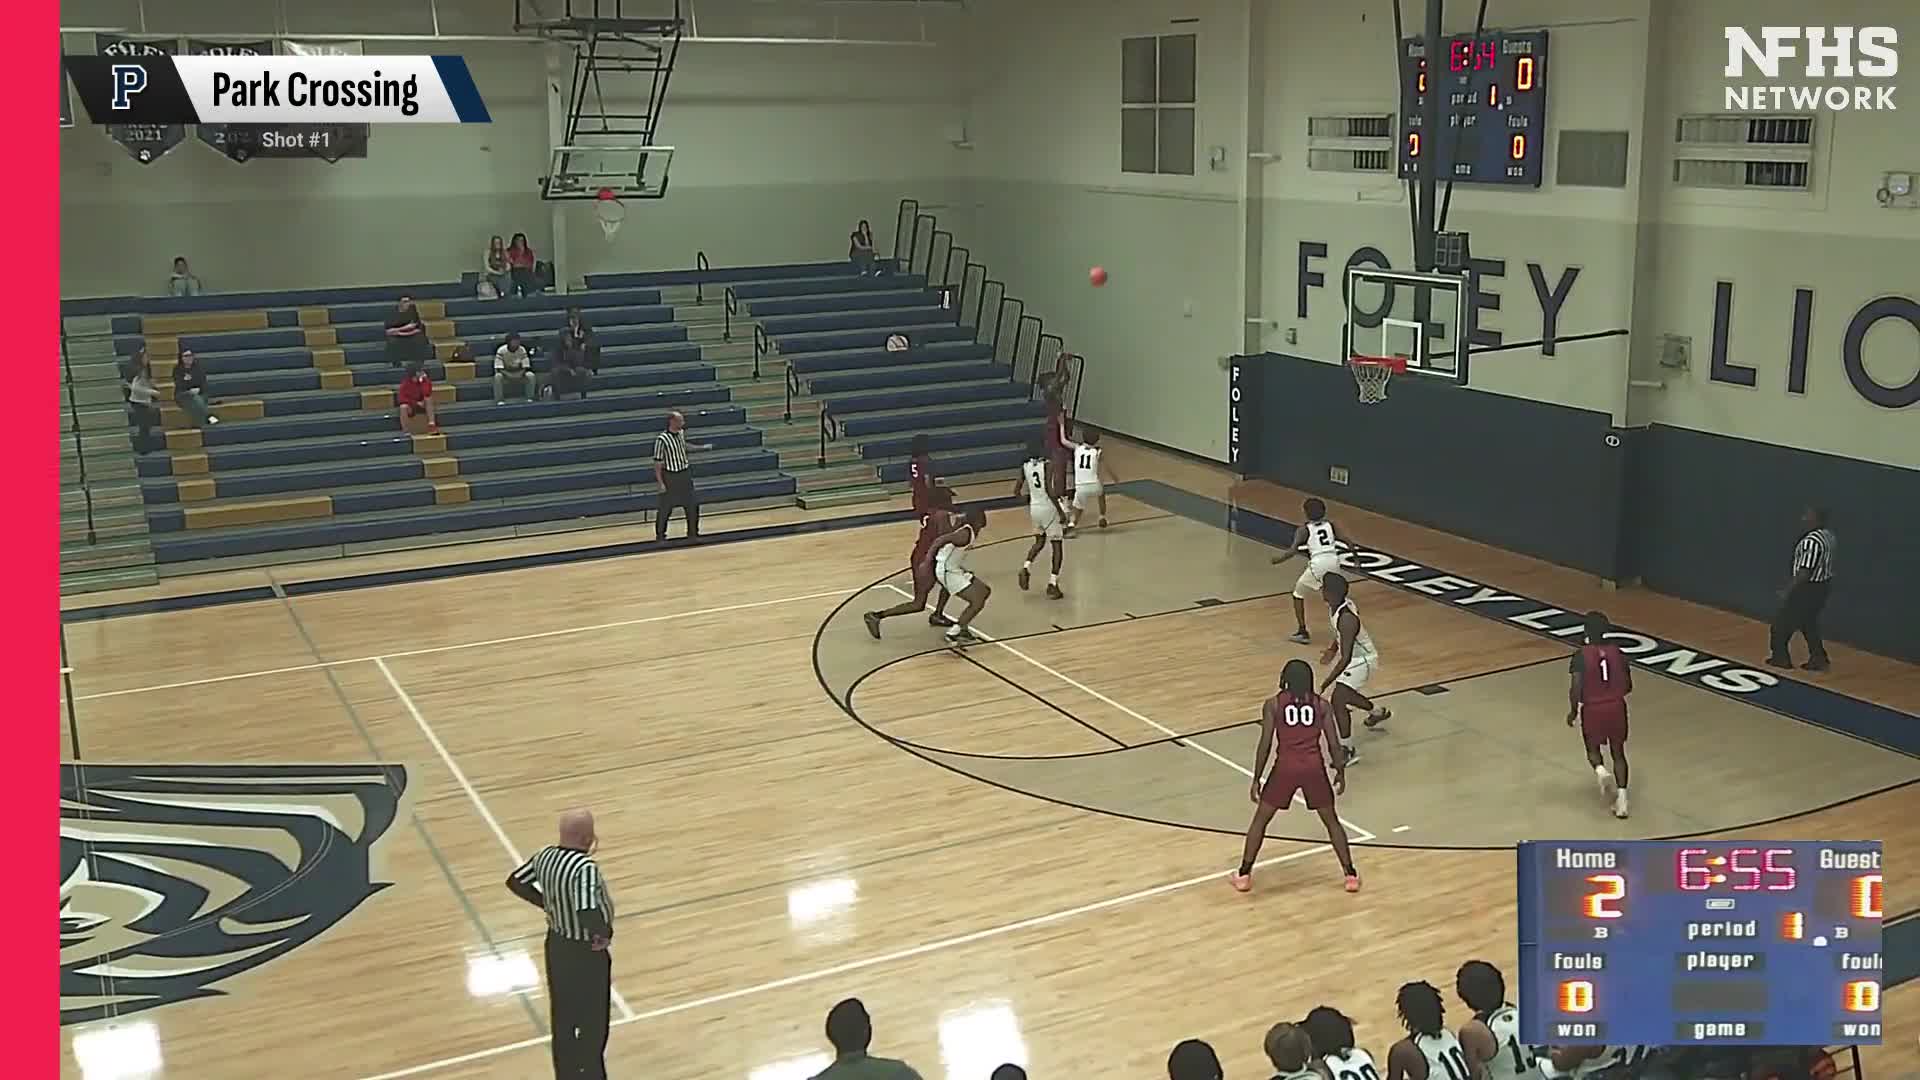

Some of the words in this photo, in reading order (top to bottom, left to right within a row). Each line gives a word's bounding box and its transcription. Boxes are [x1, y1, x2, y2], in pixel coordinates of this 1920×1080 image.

[1517, 57, 1533, 90] 0
[1513, 136, 1524, 159] 0
[1231, 366, 1241, 462] FOLEY
[911, 464, 919, 478] 5
[1079, 453, 1092, 470] 11
[1032, 471, 1042, 489] 3
[1317, 529, 1330, 546] 2
[1600, 659, 1608, 681] 1
[1284, 704, 1314, 726] 00
